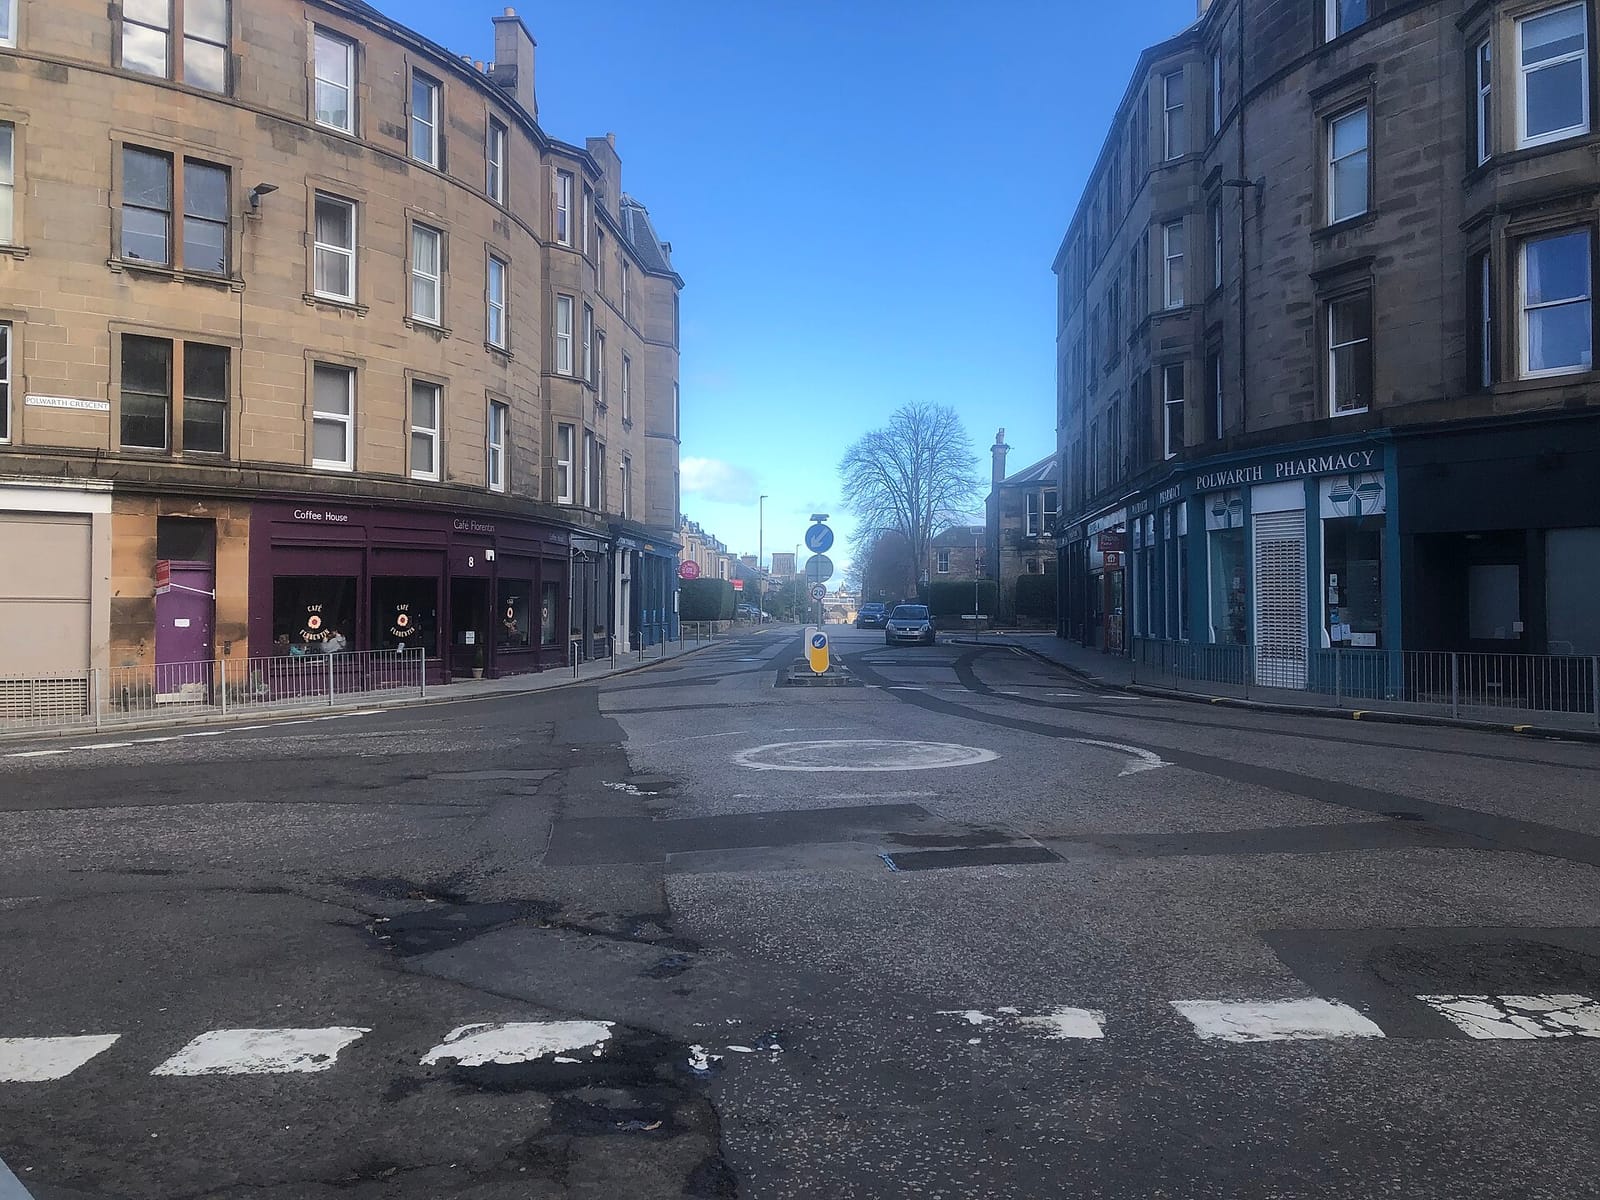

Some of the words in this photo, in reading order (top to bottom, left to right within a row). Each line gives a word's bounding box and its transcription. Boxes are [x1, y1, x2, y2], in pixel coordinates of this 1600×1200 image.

[26, 397, 67, 406] POLWARTH
[69, 400, 108, 409] CRESCENT
[1196, 466, 1262, 490] POLWARTH
[1276, 450, 1375, 478] PHARMACY
[293, 509, 322, 520] Coffee
[325, 511, 348, 522] House
[453, 519, 469, 530] Café
[470, 522, 495, 532] Florentin
[468, 556, 474, 568] 8
[813, 589, 824, 597] 20
